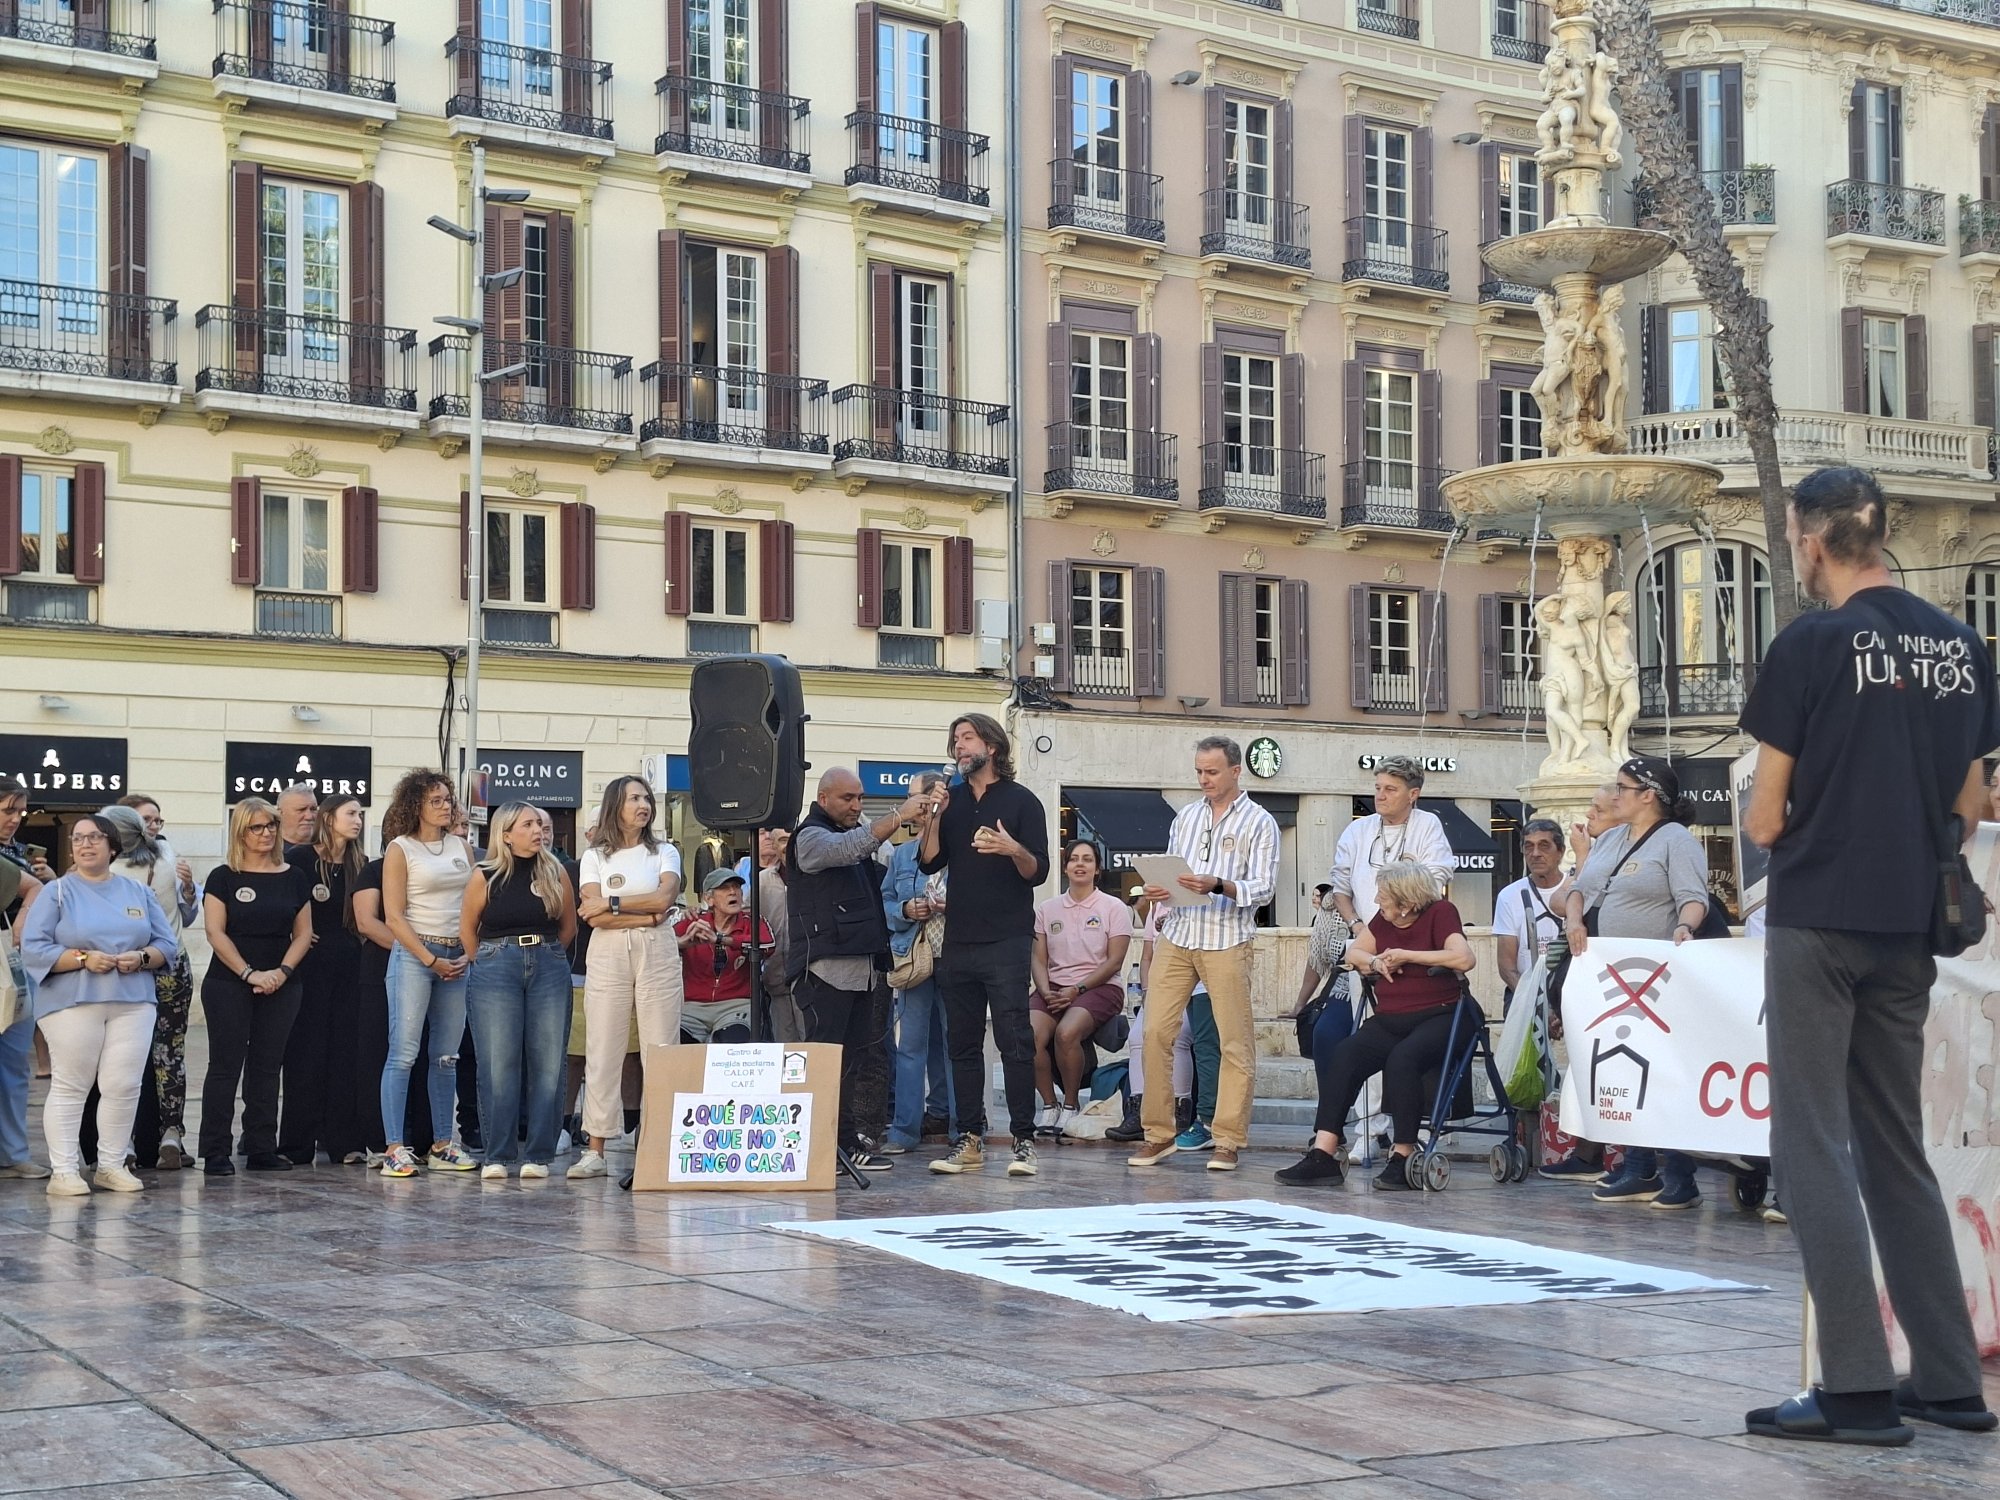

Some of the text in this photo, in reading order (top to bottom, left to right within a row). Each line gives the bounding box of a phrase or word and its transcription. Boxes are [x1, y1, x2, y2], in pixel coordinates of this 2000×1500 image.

[480, 763, 568, 778] ODGING
[880, 773, 896, 785] EL
[0, 772, 121, 790] ALPERS
[1453, 855, 1495, 869] BUCKS
[1599, 1086, 1630, 1098] NADIE
[1599, 1098, 1614, 1108] SIN
[682, 1099, 802, 1127] ¿QUÉ PASA?
[1599, 1109, 1632, 1122] HOGAR
[703, 1129, 776, 1151] QUE NO
[679, 1152, 796, 1173] TENGO CASA
[1068, 1229, 1402, 1284] NADIE
[1268, 1232, 1665, 1295] DIGNIDAD
[979, 1253, 1321, 1309] HOGAR
